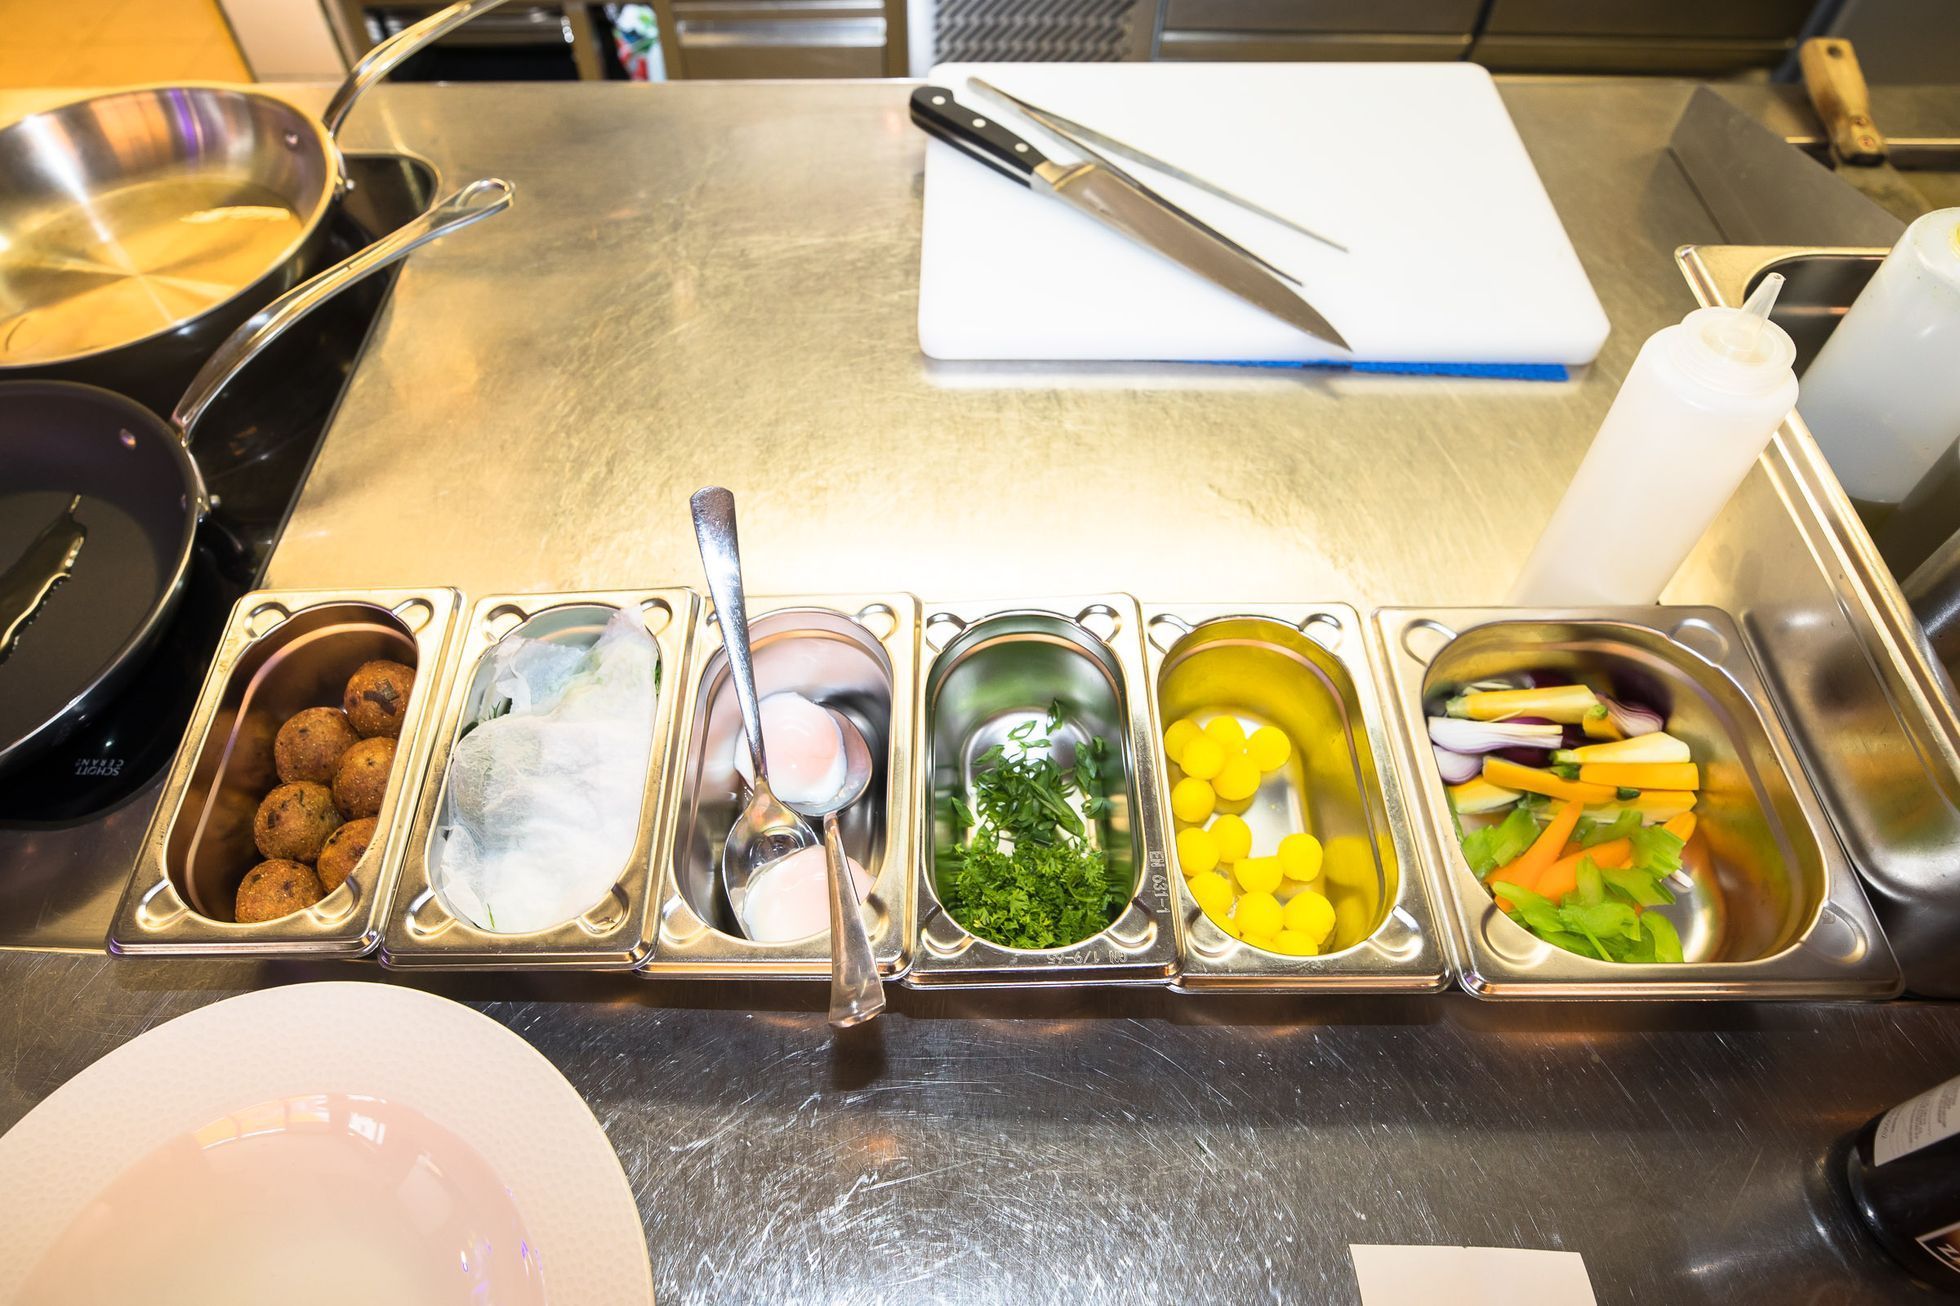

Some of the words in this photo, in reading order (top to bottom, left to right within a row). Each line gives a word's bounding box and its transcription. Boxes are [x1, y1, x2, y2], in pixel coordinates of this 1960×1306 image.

[75, 766, 120, 776] SCHOTT
[1150, 851, 1165, 868] EN
[1152, 874, 1170, 913] 631-1
[1046, 950, 1100, 964] 1/9-65
[1108, 950, 1128, 964] GN
